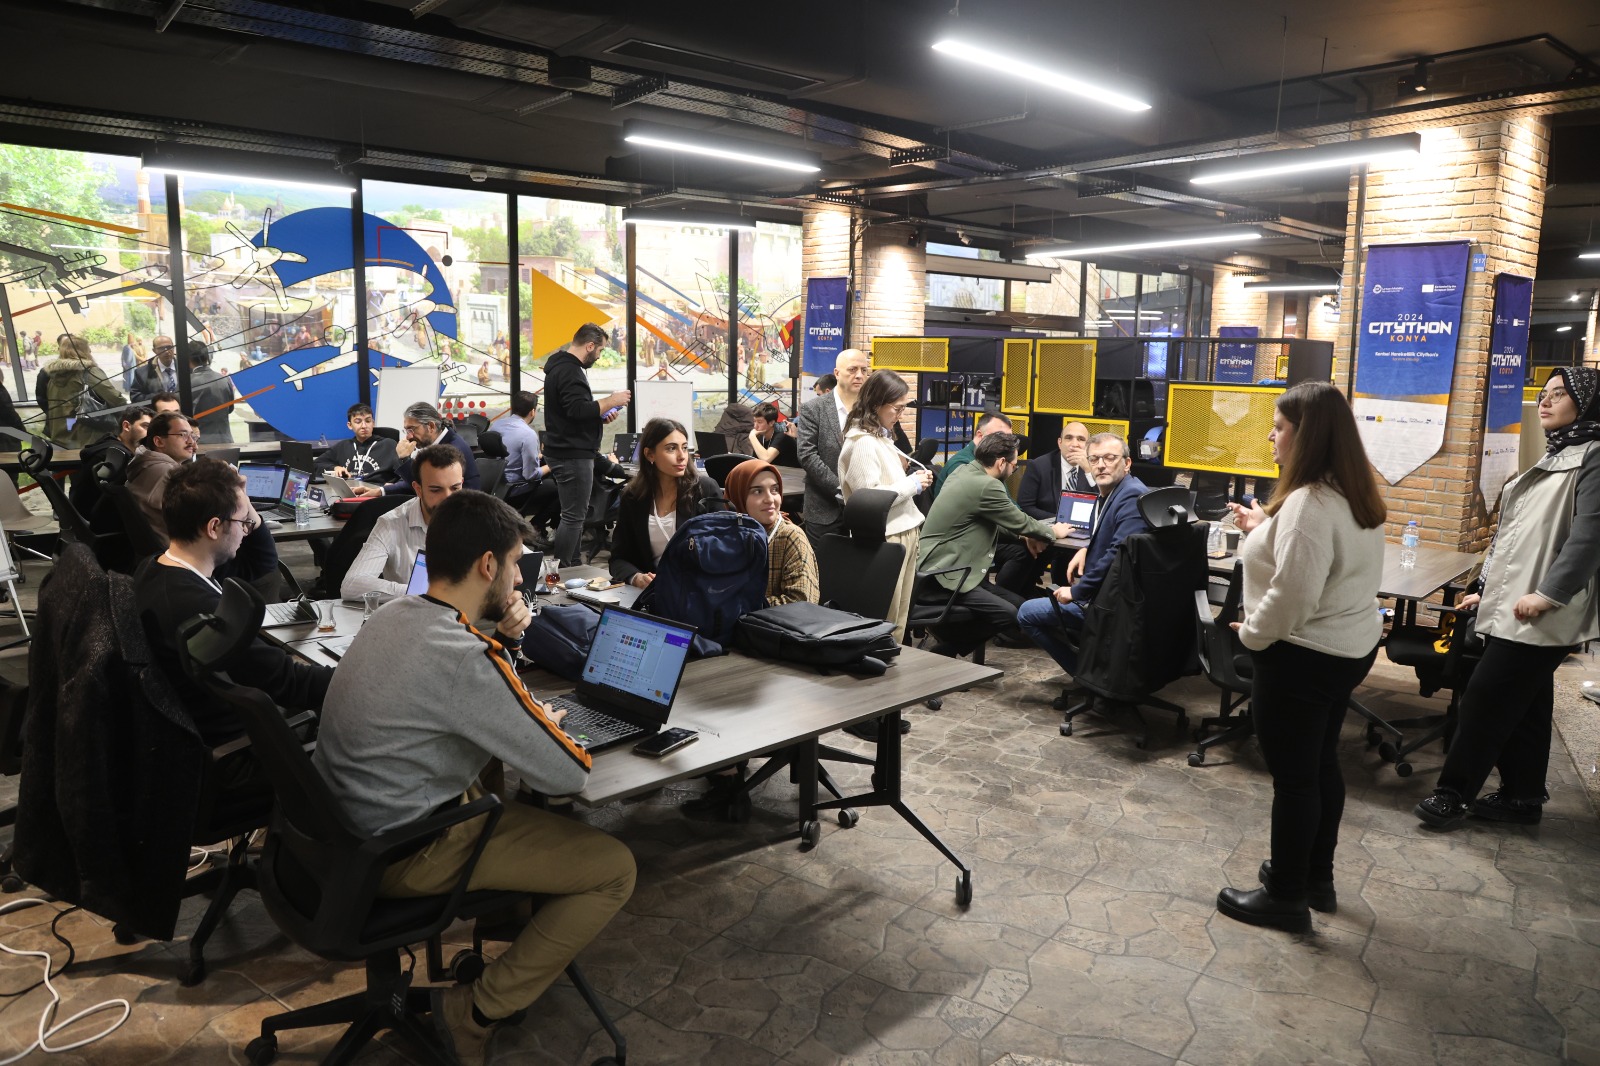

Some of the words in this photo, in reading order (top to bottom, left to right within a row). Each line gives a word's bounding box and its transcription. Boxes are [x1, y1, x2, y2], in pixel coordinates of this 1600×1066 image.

[1397, 313, 1423, 321] 2024
[809, 327, 842, 336] CITYTHON
[1368, 320, 1453, 335] CITYTHON
[1491, 354, 1522, 367] CITYTHON
